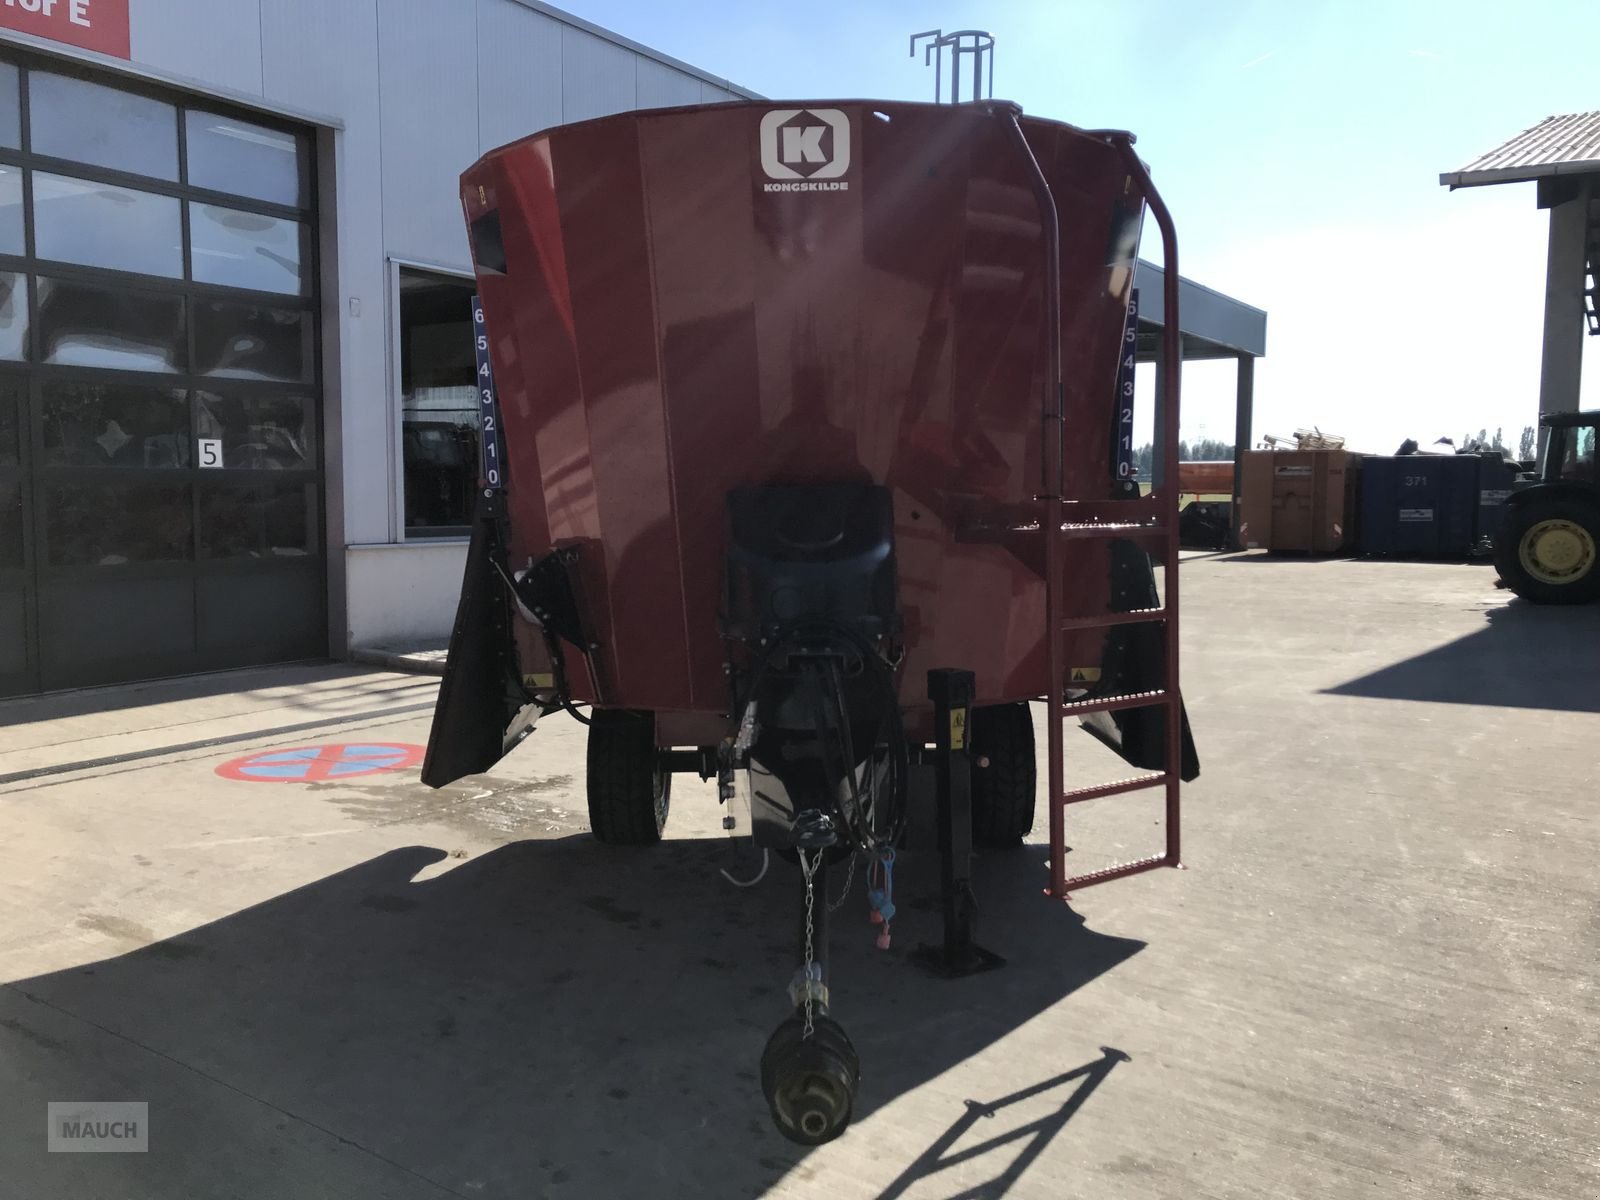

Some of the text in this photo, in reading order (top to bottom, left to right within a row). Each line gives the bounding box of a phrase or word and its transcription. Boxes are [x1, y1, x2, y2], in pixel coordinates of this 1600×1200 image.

[782, 126, 827, 163] K
[763, 182, 849, 192] KONGSKILDE
[474, 308, 498, 484] 6 5 4 3 2 1 0
[1119, 300, 1137, 477] 6 5 4 3 2 1 0
[203, 442, 217, 466] 5
[1405, 475, 1428, 486] 371
